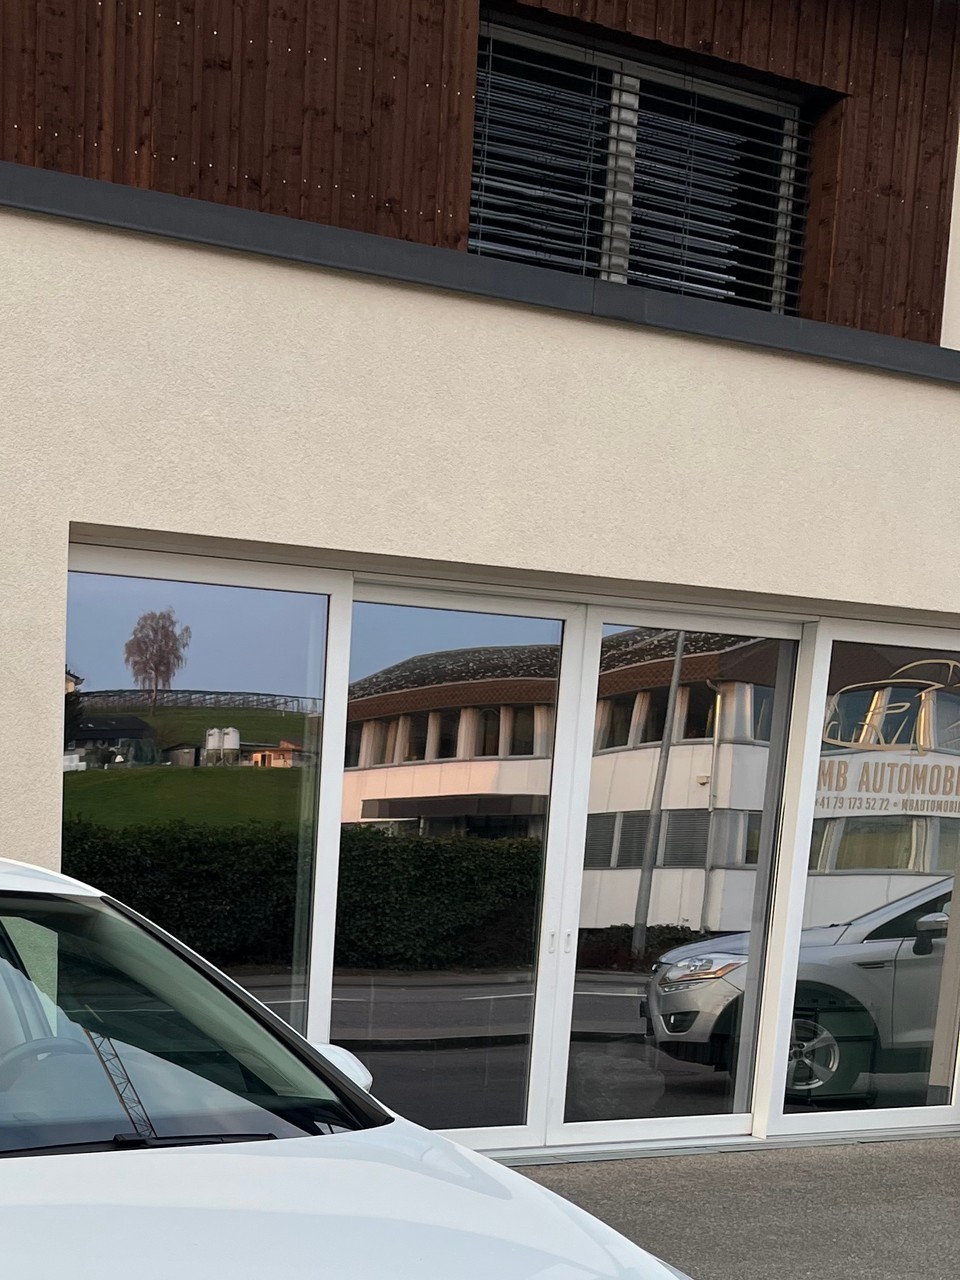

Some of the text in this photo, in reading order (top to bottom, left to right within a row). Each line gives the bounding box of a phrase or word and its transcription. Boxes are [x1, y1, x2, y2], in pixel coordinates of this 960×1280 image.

[817, 760, 849, 792] MB
[833, 796, 844, 809] 79
[848, 797, 862, 810] 173
[865, 797, 877, 811] 52
[879, 798, 890, 811] 72
